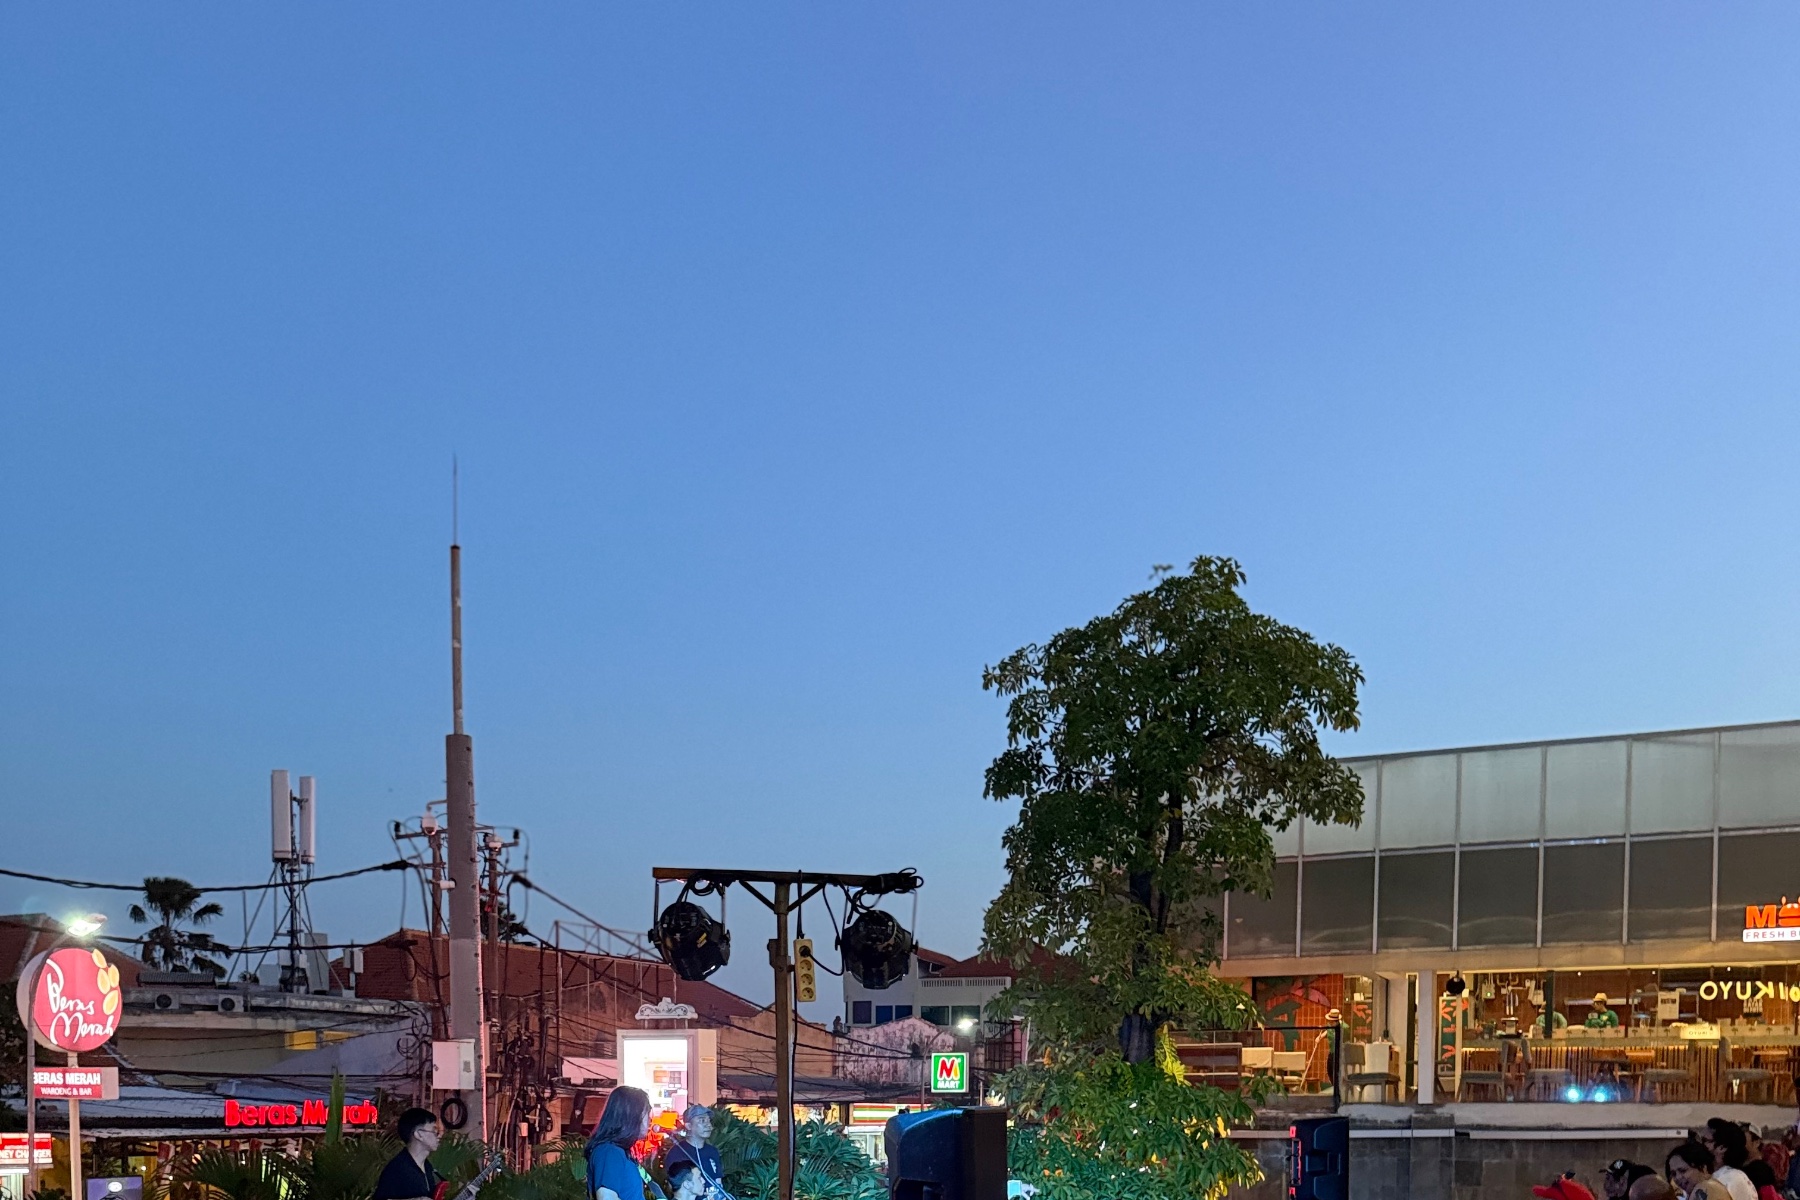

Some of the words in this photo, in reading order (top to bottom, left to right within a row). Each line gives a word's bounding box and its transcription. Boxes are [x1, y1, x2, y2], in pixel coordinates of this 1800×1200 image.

[1745, 931, 1785, 940] FRESH
[46, 959, 95, 1015] Beras
[49, 1012, 115, 1045] Merah
[65, 1072, 101, 1085] MERAH
[937, 1080, 961, 1089] MART
[79, 1088, 92, 1096] BAR
[225, 1099, 298, 1126] Beras
[302, 1099, 378, 1125] Mrah
